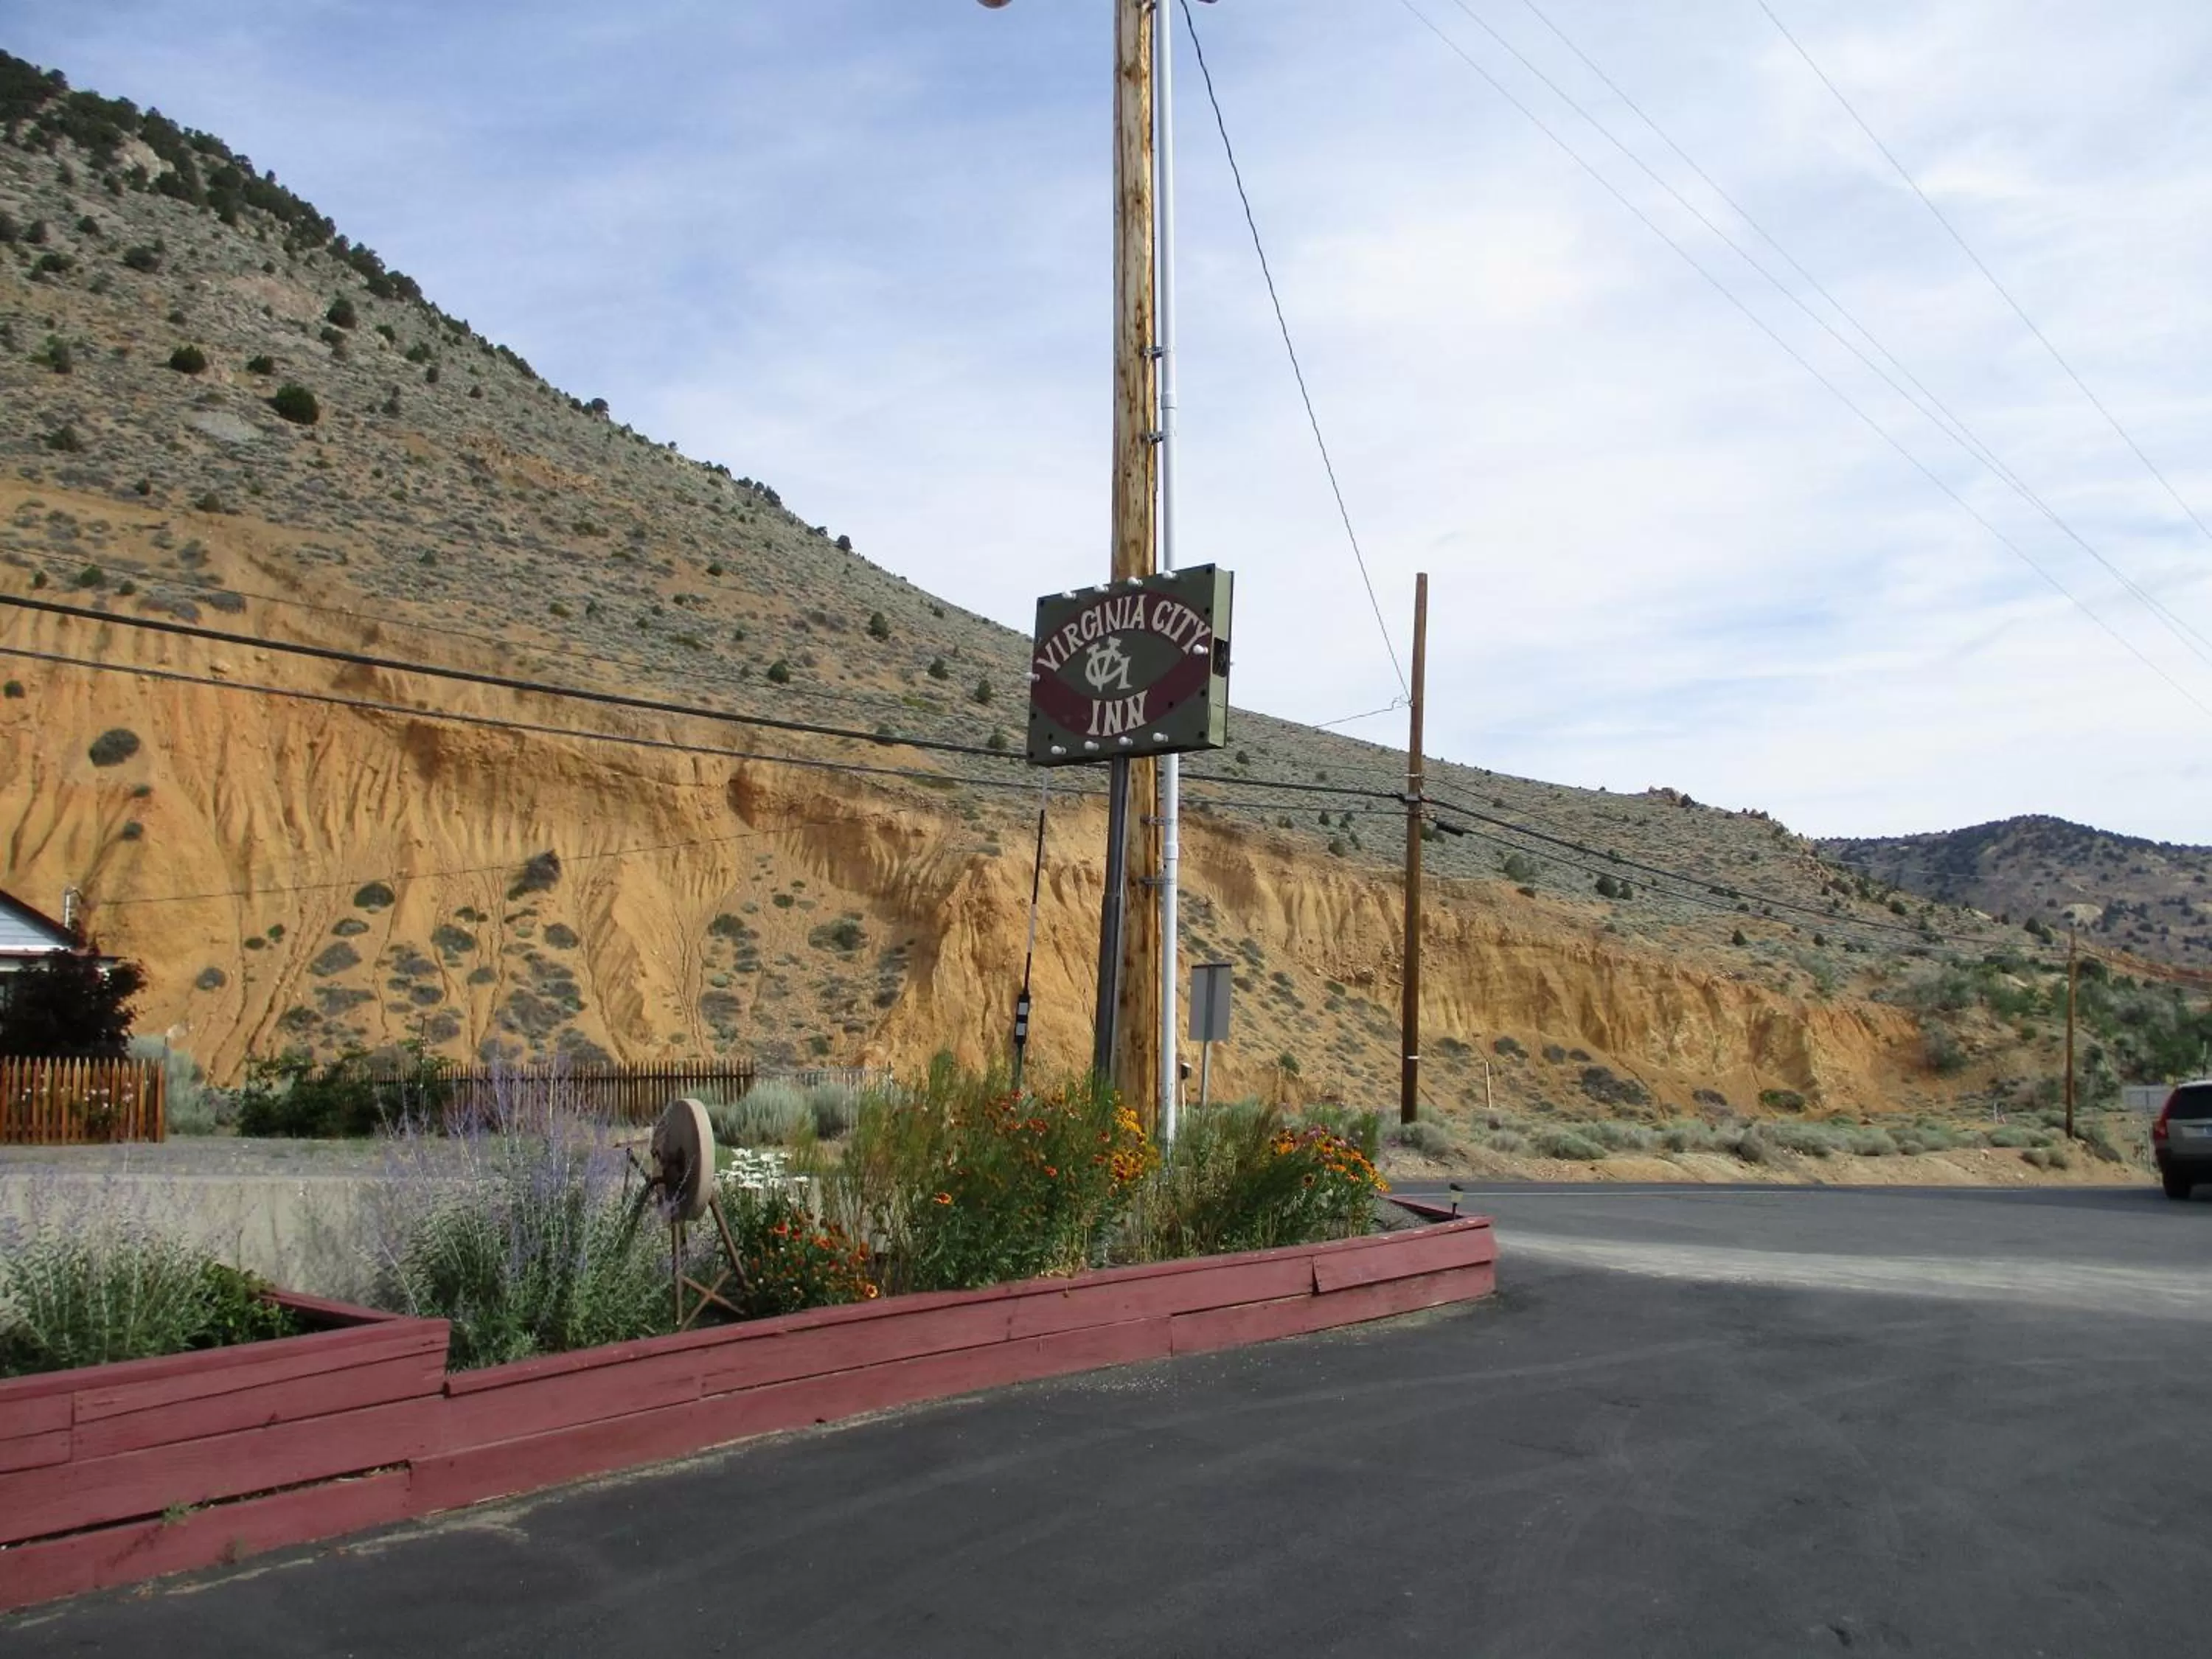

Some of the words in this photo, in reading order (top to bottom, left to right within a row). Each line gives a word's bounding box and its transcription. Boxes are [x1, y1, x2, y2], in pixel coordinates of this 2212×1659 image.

[1037, 594, 1147, 672] VIRGINIA
[1152, 600, 1211, 655] CITY
[1087, 691, 1147, 736] INN
